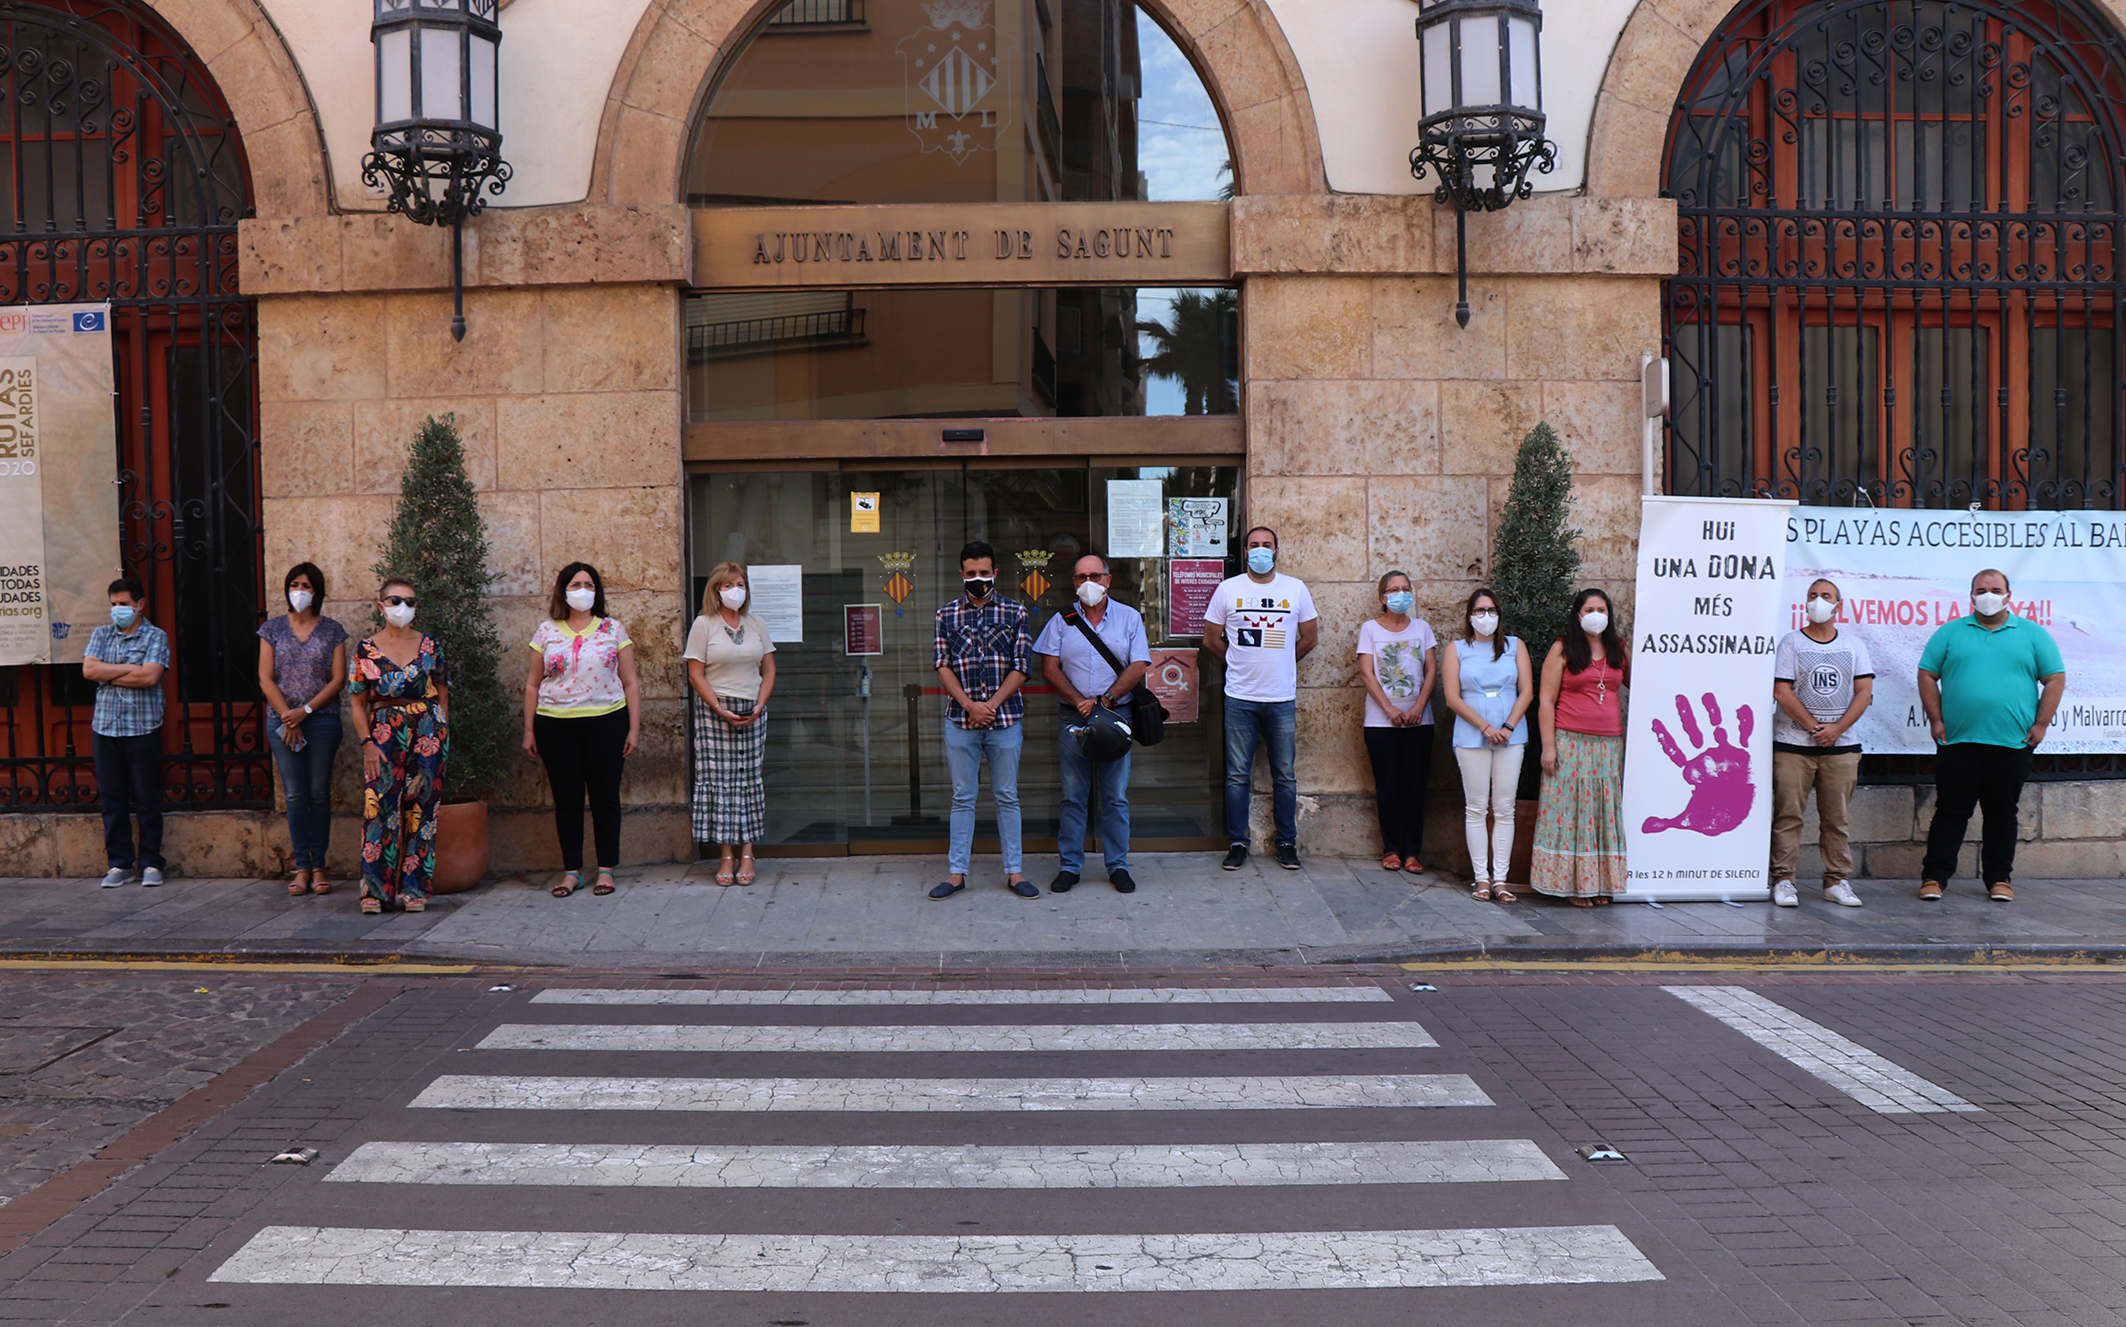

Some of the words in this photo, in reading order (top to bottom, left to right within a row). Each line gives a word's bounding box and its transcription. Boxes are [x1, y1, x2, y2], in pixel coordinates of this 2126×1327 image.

[915, 111, 938, 130] M
[980, 110, 999, 128] L
[753, 229, 969, 264] AJUNTAMENT
[995, 229, 1033, 260] DE
[1058, 227, 1174, 260] SAGUNT
[1702, 520, 1735, 541] HUI
[1804, 517, 1901, 546] PLAYAS
[1907, 520, 2049, 548] ACCESIBLES
[2053, 522, 2083, 547] AL
[1653, 557, 1698, 578] UNA
[1708, 554, 1776, 580] DONA
[1, 578, 41, 590] TODAS
[1694, 593, 1734, 617] MÉS
[1641, 633, 1776, 655] ASSASSINADA
[1814, 673, 1837, 687] INS
[2061, 710, 2069, 732] y
[1635, 870, 1649, 879] les
[1652, 870, 1665, 879] 12
[1667, 870, 1673, 879] h
[1710, 869, 1722, 879] DE
[1725, 869, 1760, 879] SILENCI
